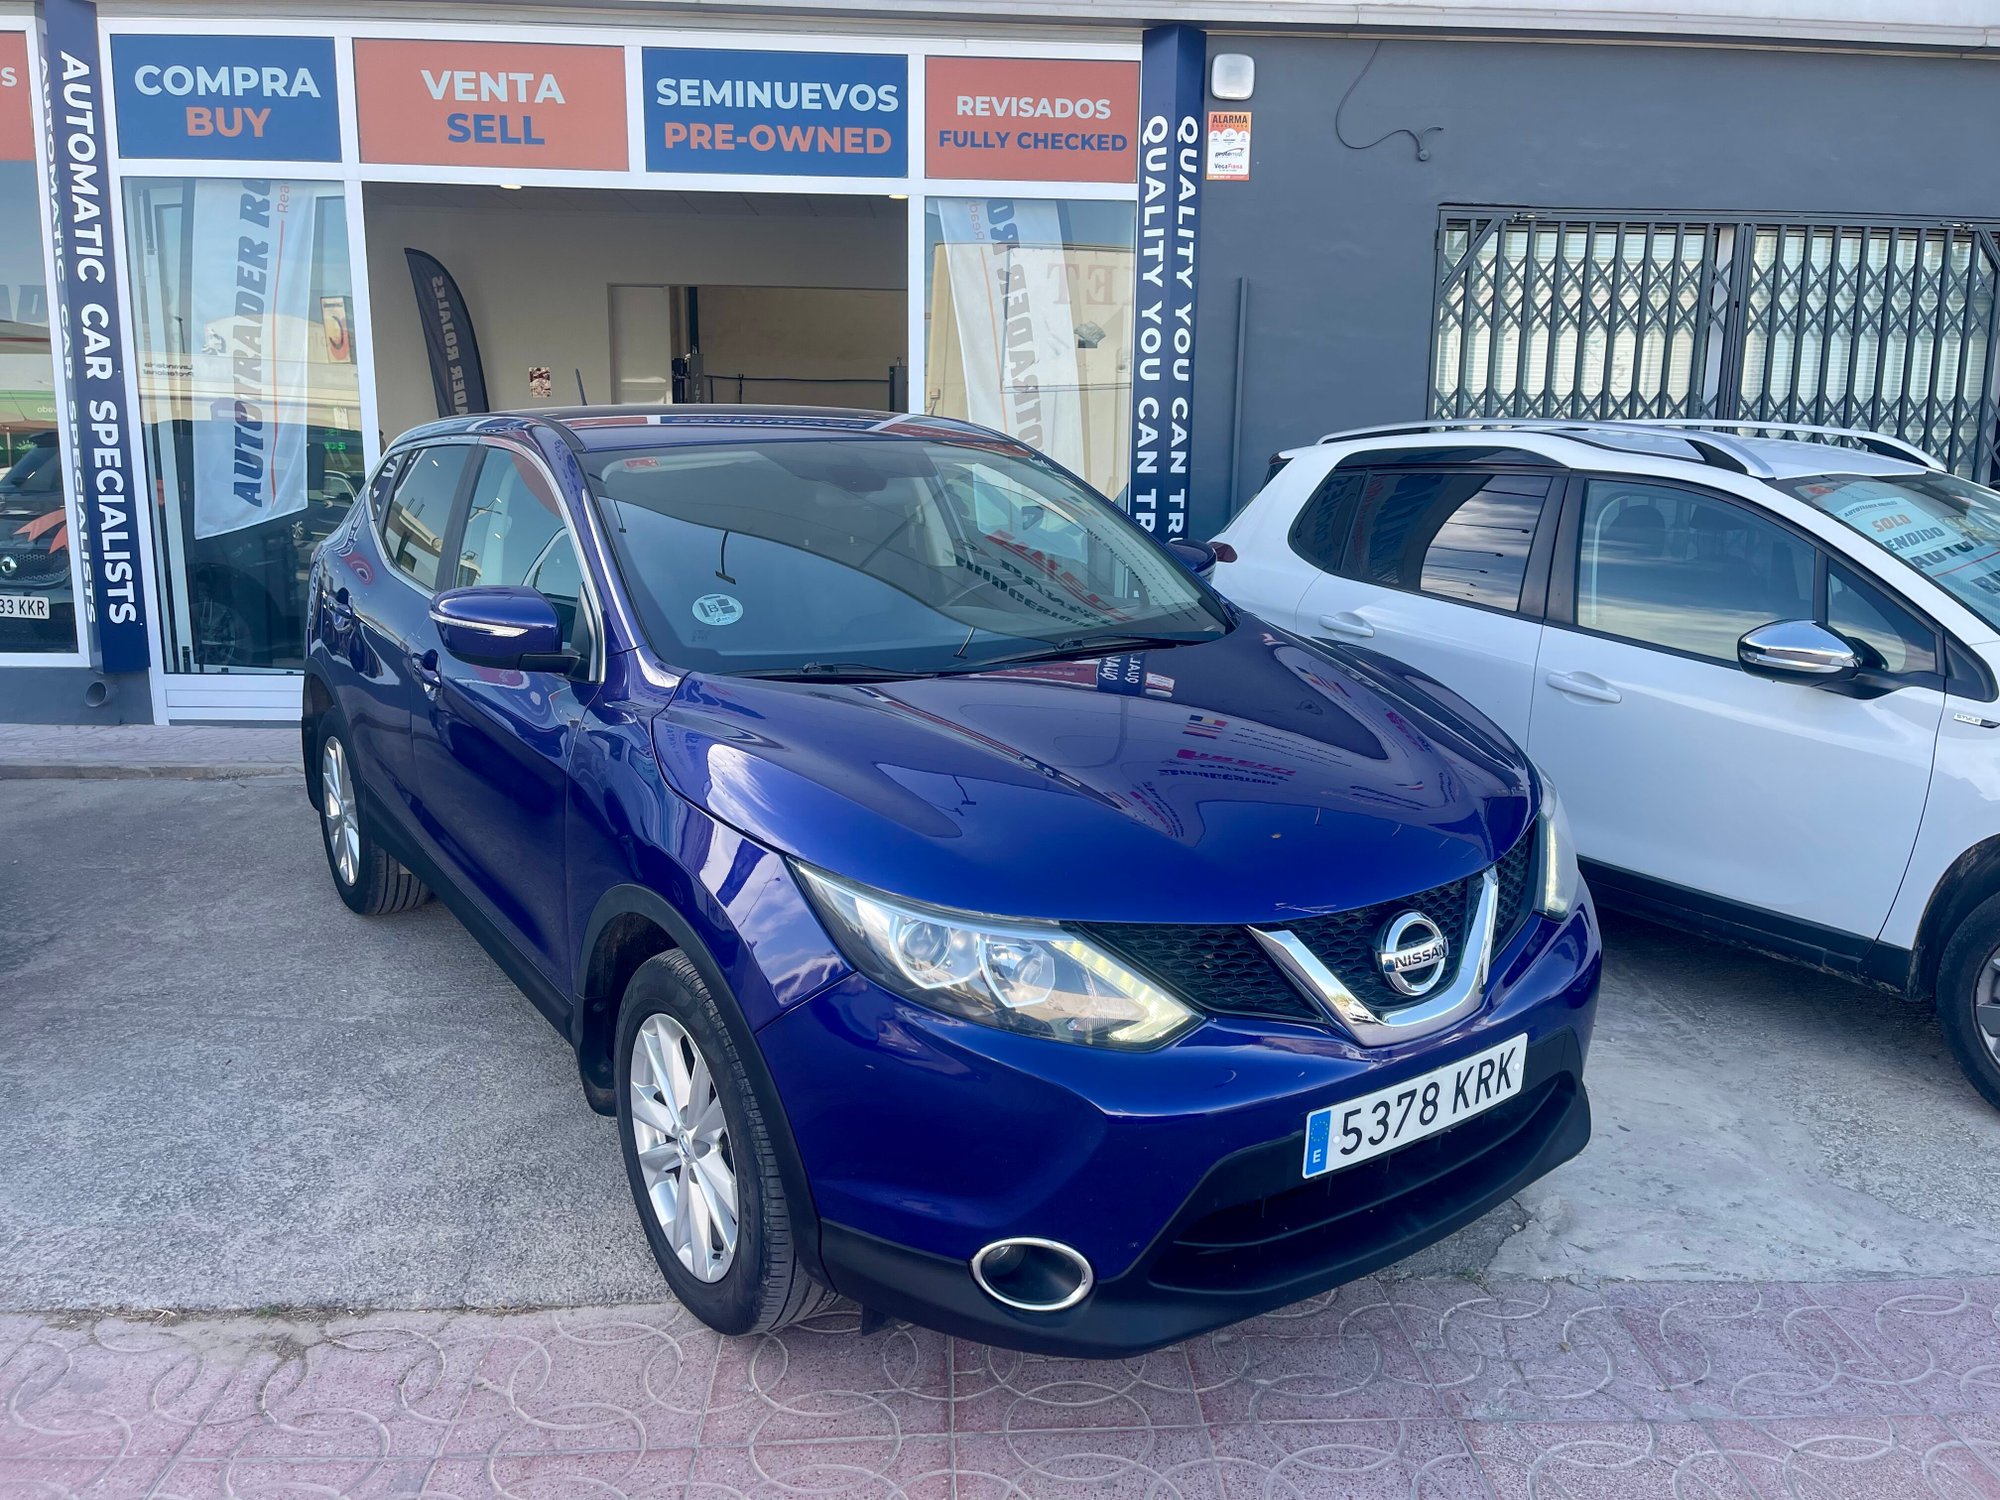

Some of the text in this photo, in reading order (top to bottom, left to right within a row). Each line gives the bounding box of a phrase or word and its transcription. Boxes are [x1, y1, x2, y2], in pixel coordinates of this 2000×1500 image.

[134, 64, 321, 98] COMPRA
[420, 69, 566, 104] VENTA
[656, 77, 899, 112] SEMINUEVOS
[186, 106, 272, 138] BUY
[956, 95, 1112, 120] REVISADOS
[1212, 114, 1248, 124] ALARMA
[447, 112, 546, 145] SELL
[664, 122, 893, 154] PRE-OWNED
[939, 130, 1128, 151] FULLY CHECKED
[1141, 115, 1169, 288] QUALITY
[1175, 115, 1199, 290] QUALITY
[40, 56, 96, 624] AUTOMATIC CAR SPECIALISTS
[60, 50, 137, 624] AUTOMATIC CAR SPECIALISTS
[1139, 301, 1163, 381] YOU
[1173, 302, 1192, 382] YOU
[1136, 397, 1160, 474] CAN
[1170, 397, 1189, 474] CAN
[1871, 513, 1912, 533] SOLD
[1882, 527, 1946, 551] ENDIDO
[19, 599, 46, 616] KKR
[1394, 939, 1448, 969] NISSAN
[1312, 1046, 1517, 1164] E 5378 KRK
